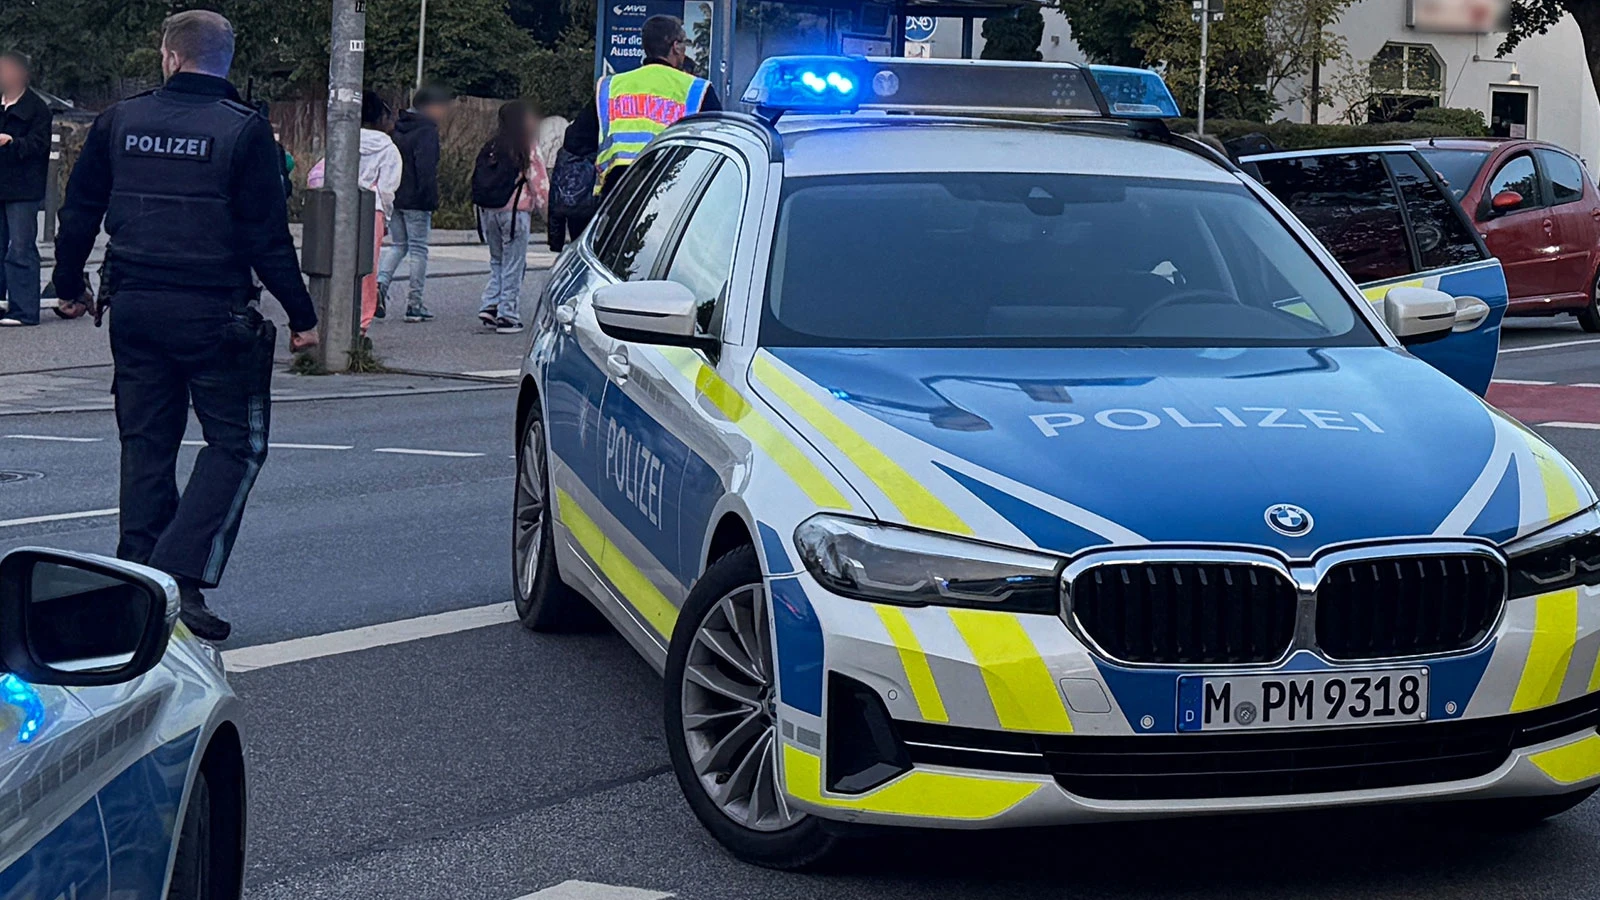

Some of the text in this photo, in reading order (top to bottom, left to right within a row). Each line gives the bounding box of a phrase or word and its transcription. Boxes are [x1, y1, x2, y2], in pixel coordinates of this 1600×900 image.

[611, 34, 642, 45] Für dic
[125, 134, 207, 156] POLIZEI
[1028, 406, 1385, 438] POLIZEI
[606, 416, 665, 531] POLIZEI
[1204, 675, 1420, 724] M PM 9318
[1185, 710, 1195, 722] D
